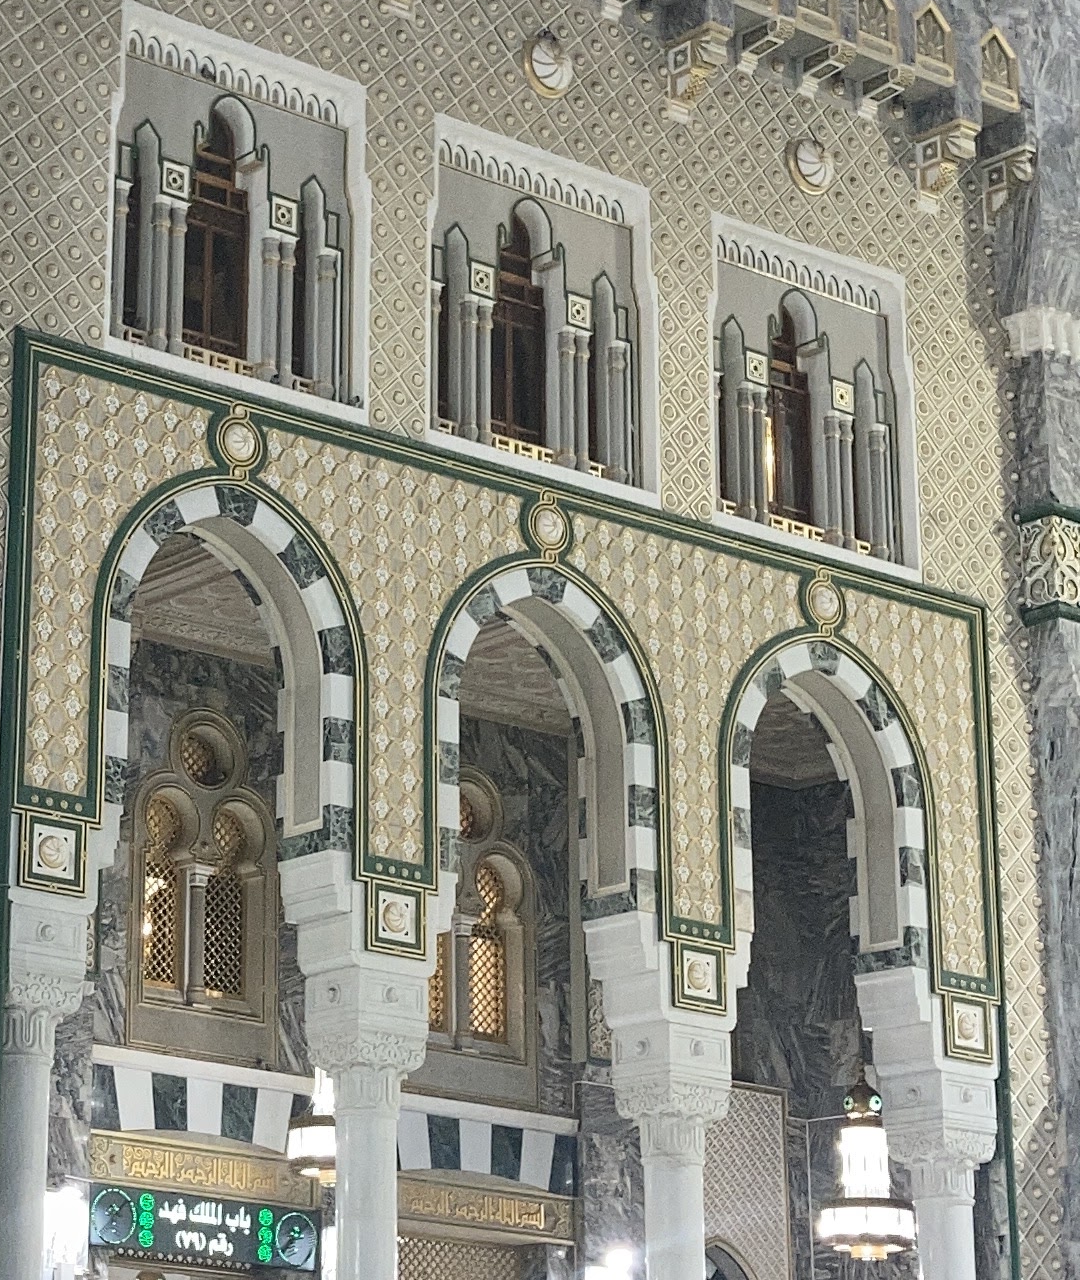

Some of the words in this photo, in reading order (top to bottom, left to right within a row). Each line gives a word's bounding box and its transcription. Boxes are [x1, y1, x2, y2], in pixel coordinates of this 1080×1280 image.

[158, 1198, 187, 1225] فهد
[189, 1201, 223, 1226] الملك
[225, 1206, 251, 1235] باب
[176, 1230, 207, 1251] (٧٩)
[209, 1232, 234, 1257] رقم
